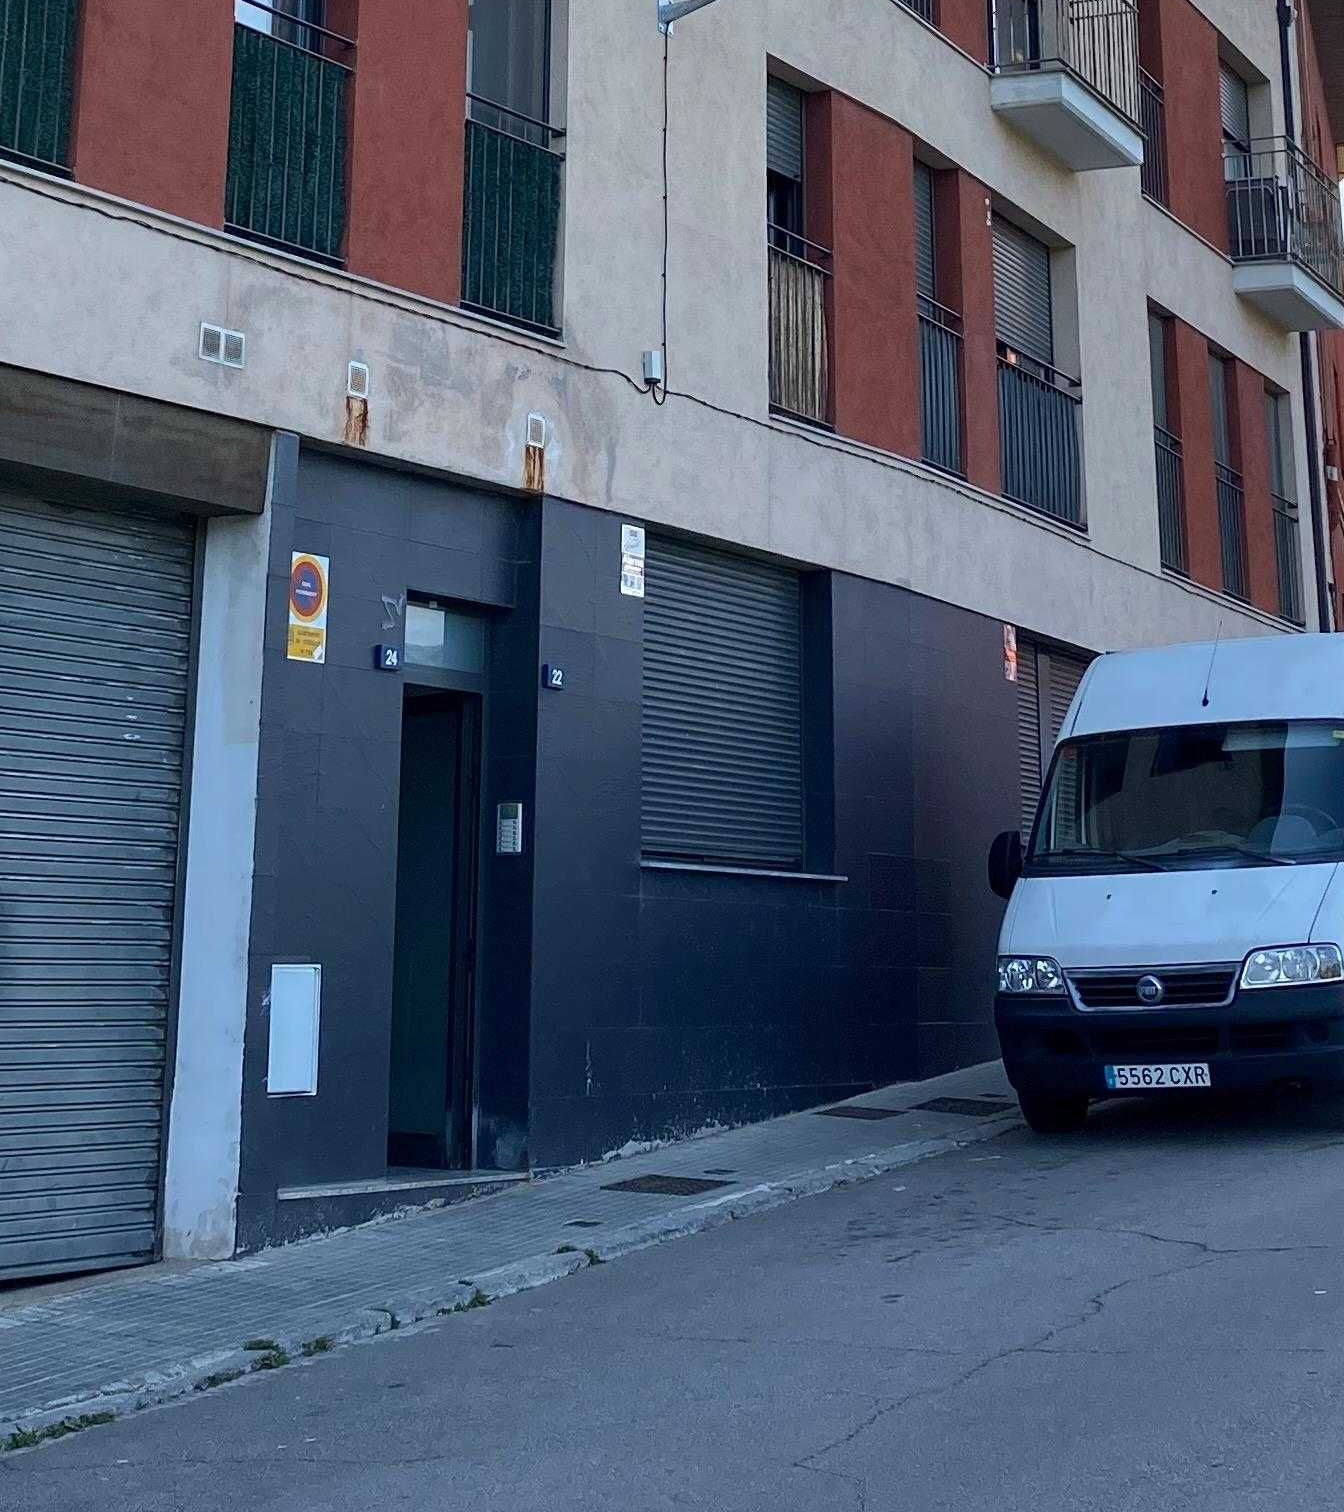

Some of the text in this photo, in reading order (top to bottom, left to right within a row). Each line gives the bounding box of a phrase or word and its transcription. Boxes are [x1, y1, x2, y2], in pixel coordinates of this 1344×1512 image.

[385, 649, 398, 666] 24
[551, 668, 563, 686] 22
[1117, 1066, 1205, 1086] 5562 CXR
